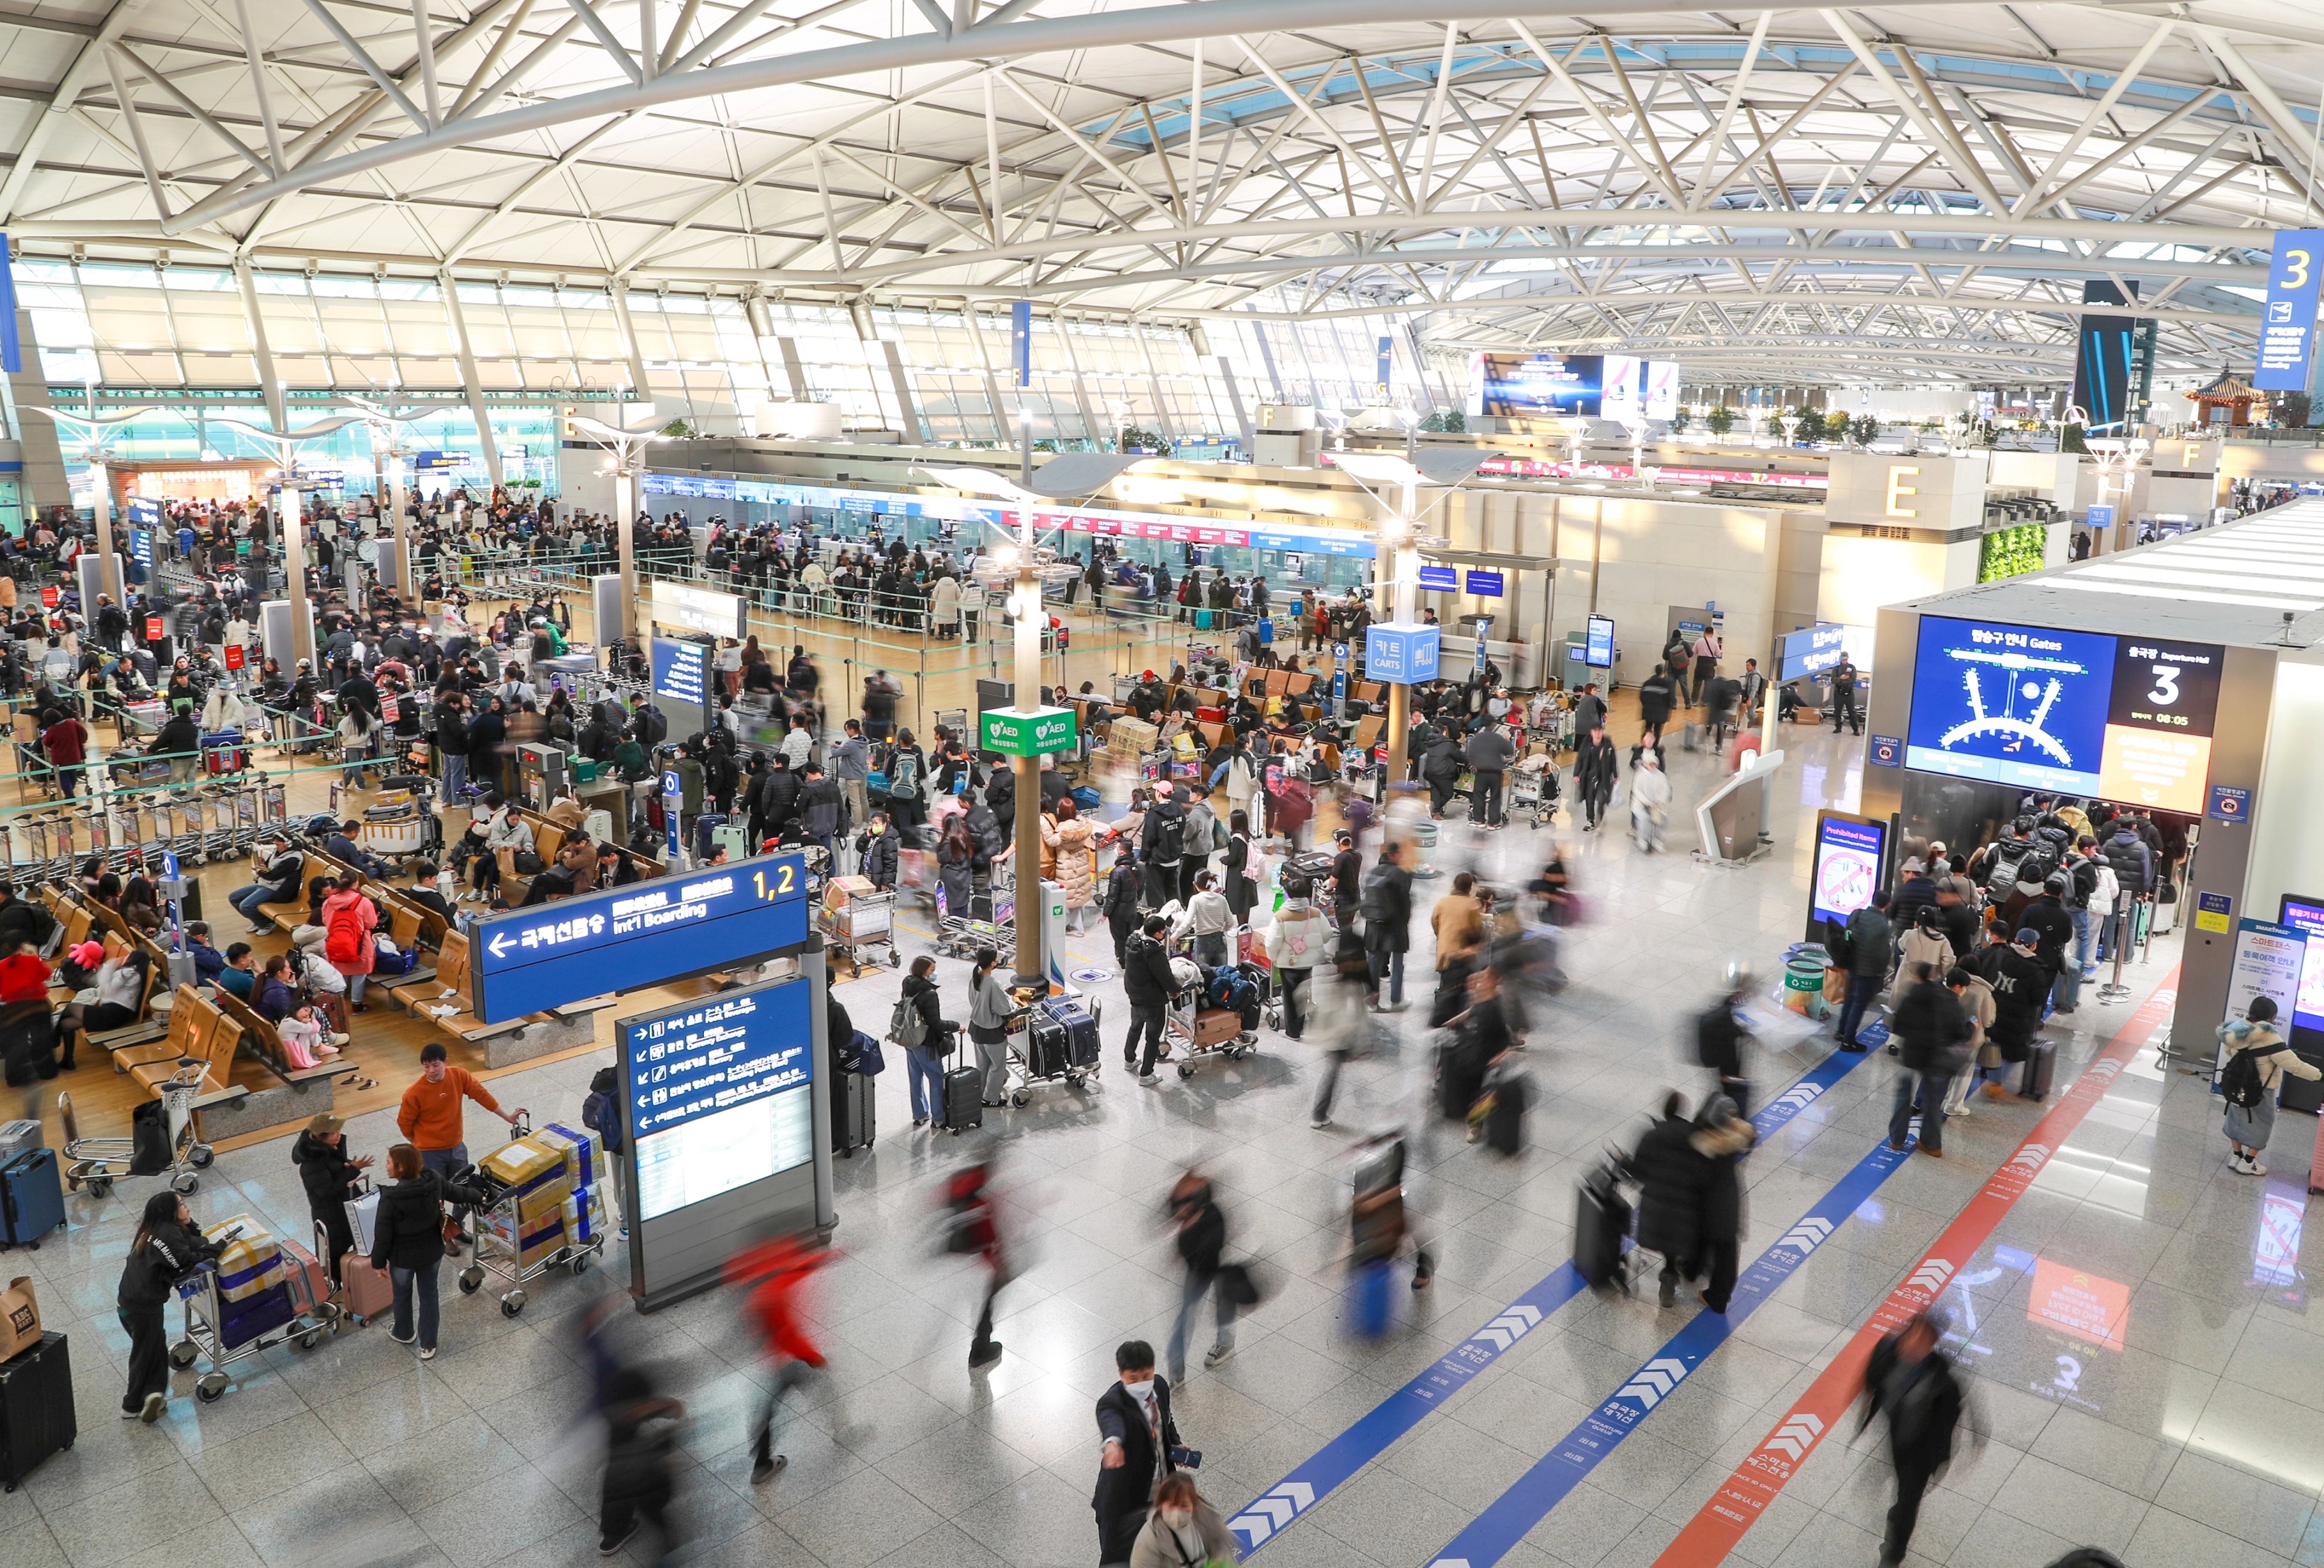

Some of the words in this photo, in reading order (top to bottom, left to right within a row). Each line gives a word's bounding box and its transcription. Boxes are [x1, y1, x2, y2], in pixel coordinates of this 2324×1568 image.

[2280, 249, 2311, 289] 3
[1012, 368, 1022, 385] F
[1377, 382, 1387, 394] G
[1263, 408, 1275, 427] F
[2183, 444, 2202, 469] F
[1885, 465, 1921, 518] E
[1320, 518, 1334, 527] E35
[1353, 521, 1368, 529] E36
[1971, 629, 2004, 646] 탑승구
[2004, 632, 2029, 648] 안내
[2029, 637, 2063, 651] Gates
[1376, 640, 1401, 658] 카트
[2128, 646, 2158, 660] 출국장
[2160, 652, 2196, 664] Departure
[2195, 656, 2211, 665] Hall
[1375, 658, 1400, 670] CARTS
[2147, 664, 2181, 706] 3
[2156, 713, 2188, 727] 08:05
[1002, 726, 1018, 736] AED
[1049, 723, 1066, 734] AED
[990, 738, 1018, 749] 자동심장충격기
[1036, 737, 1066, 747] 자동심장충격기
[1826, 826, 1859, 840] Prohibited
[1859, 833, 1877, 843] Items
[752, 864, 795, 901] 1,2
[612, 915, 641, 936] Int'l
[643, 902, 707, 930] Boarding
[2289, 908, 2311, 919] 항공기
[520, 913, 606, 950] 국제선탑승
[2255, 924, 2289, 935] SMARTPASS
[2250, 936, 2291, 951] 스마트패스
[2243, 951, 2275, 963] 등록여객
[2277, 957, 2295, 967] 안내
[1993, 971, 2018, 993] NY
[2242, 984, 2266, 993] 스마트패스
[2266, 989, 2285, 997] 사전등록
[724, 1004, 757, 1019] Beverages
[686, 1036, 715, 1051] Currency
[715, 1029, 747, 1043] Exchange
[708, 1054, 733, 1066] Nursery
[727, 1069, 754, 1082] Meeting
[754, 1064, 771, 1077] Point
[770, 1057, 789, 1072] (East)
[153, 1238, 166, 1250] ARE
[1769, 1252, 1796, 1265] 대기선
[1772, 1248, 1800, 1260] 출국장
[1758, 1261, 1790, 1273] DEPARTURE
[1894, 1289, 1931, 1305] 패스전용
[1901, 1287, 1931, 1300] 스마트
[14, 1308, 31, 1323] ABC
[17, 1316, 33, 1330] MART
[1458, 1349, 1486, 1365] 대기선
[1462, 1344, 1493, 1358] 출국장
[1442, 1359, 1475, 1374] DEPARTURE
[1444, 1365, 1465, 1375] QUEUE
[1431, 1376, 1449, 1386] 出境
[1415, 1388, 1434, 1399] 出国
[1603, 1407, 1634, 1424] 대기선
[1608, 1402, 1641, 1417] 출국장
[1588, 1418, 1625, 1436] DEPARTURE
[1591, 1425, 1614, 1436] QUEUE
[1579, 1437, 1599, 1448] 出境
[1564, 1451, 1584, 1463] 出国
[1757, 1454, 1791, 1470] 스마트
[1746, 1456, 1790, 1479] 패스전용
[1733, 1472, 1751, 1482] FACE
[1759, 1483, 1779, 1493] ONLY
[1720, 1489, 1763, 1509] 人脸认证
[1713, 1505, 1746, 1523] 顔認証
